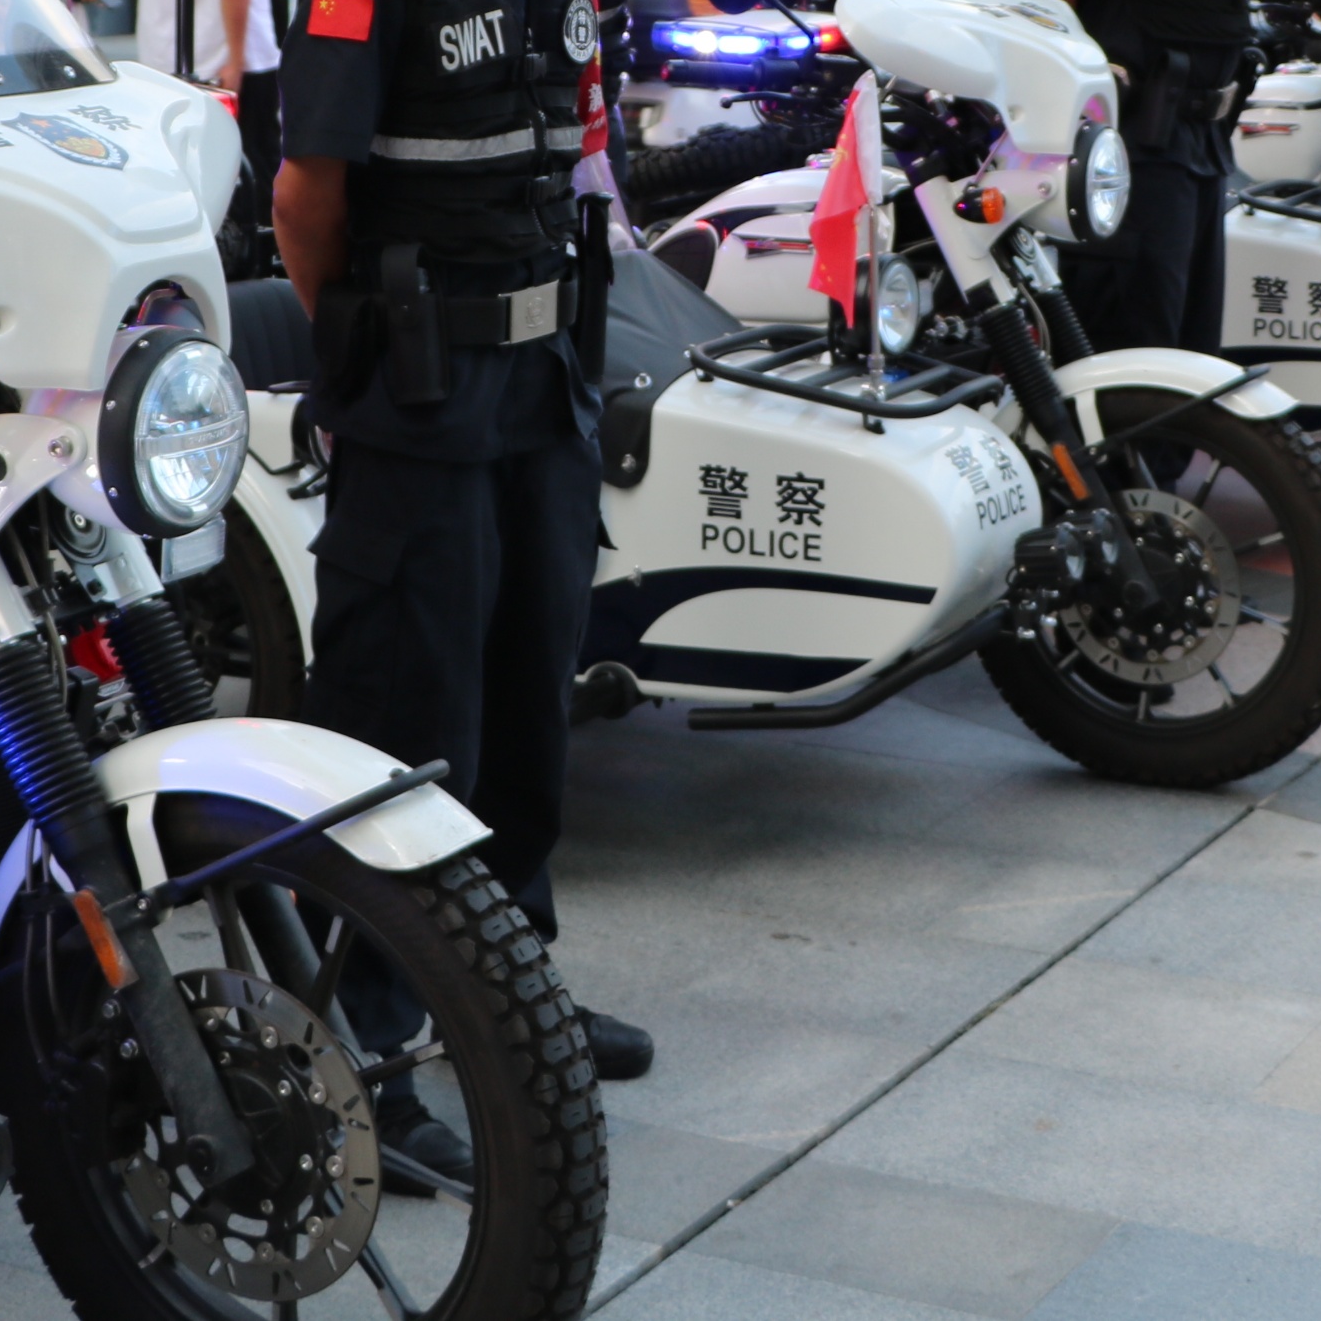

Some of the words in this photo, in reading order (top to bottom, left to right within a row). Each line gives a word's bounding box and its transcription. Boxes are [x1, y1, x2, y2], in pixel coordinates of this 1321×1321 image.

[439, 9, 506, 71] SWAT
[699, 464, 826, 527] 警察
[976, 484, 1027, 530] POLICE
[701, 523, 822, 562] POLICE
